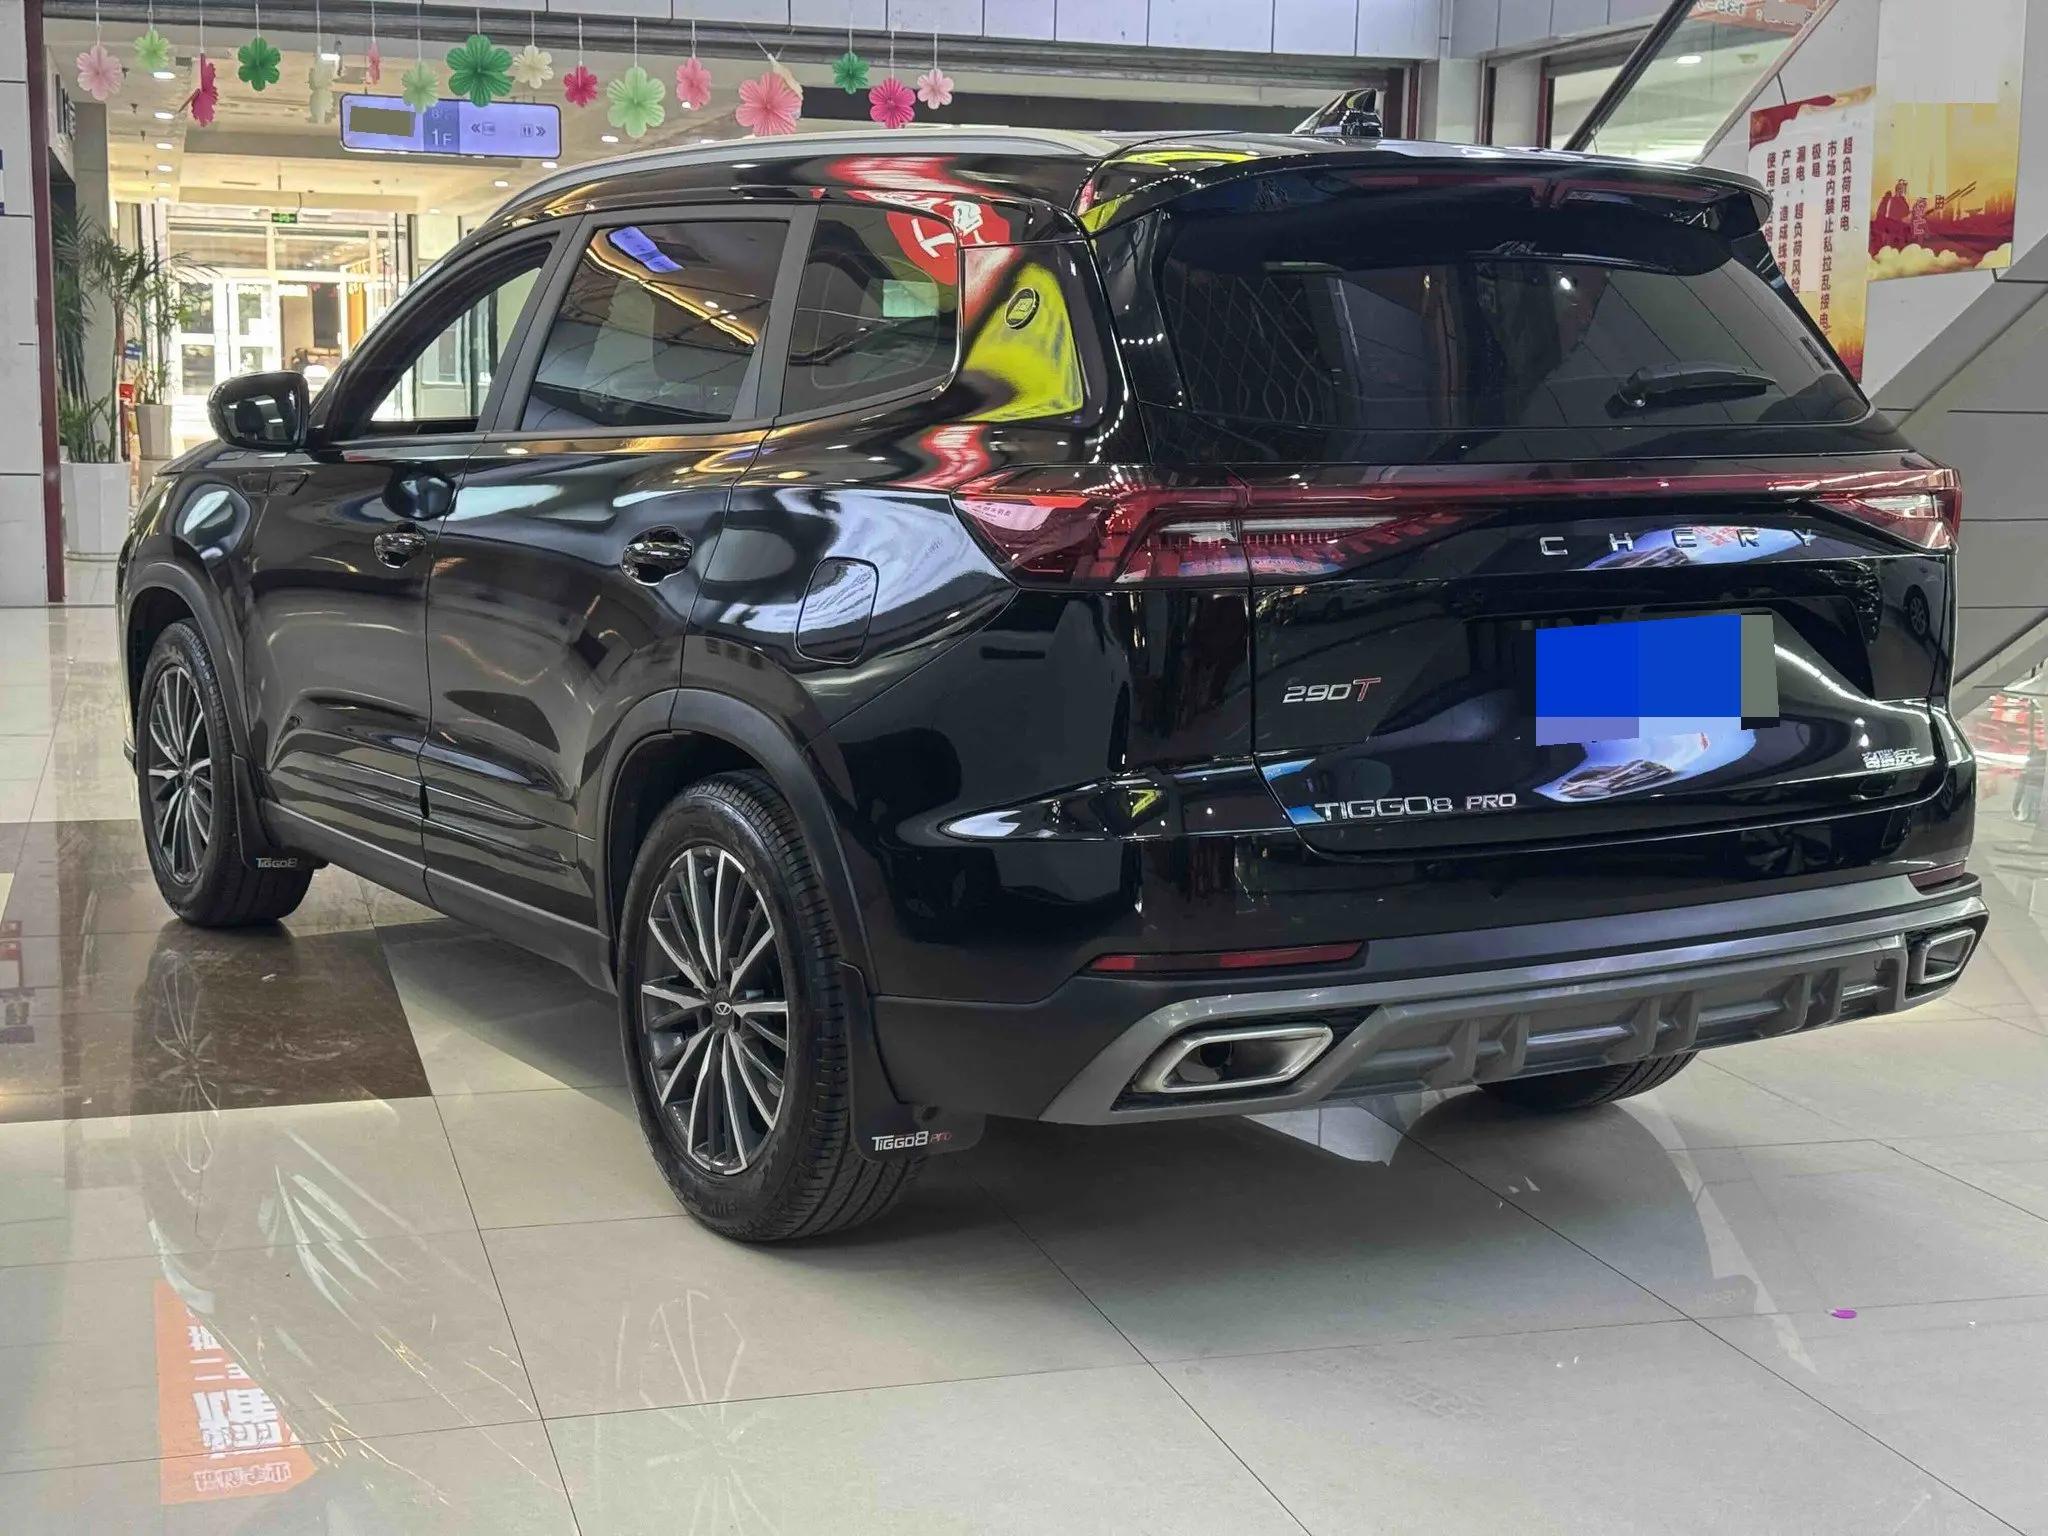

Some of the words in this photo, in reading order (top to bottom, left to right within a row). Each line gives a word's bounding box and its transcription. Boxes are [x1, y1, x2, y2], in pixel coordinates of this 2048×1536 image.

[431, 128, 452, 147] 1F
[1539, 527, 1813, 556] CHERY
[1282, 677, 1382, 704] 290T
[1314, 796, 1453, 822] TIGGO8
[1466, 793, 1517, 810] PRO
